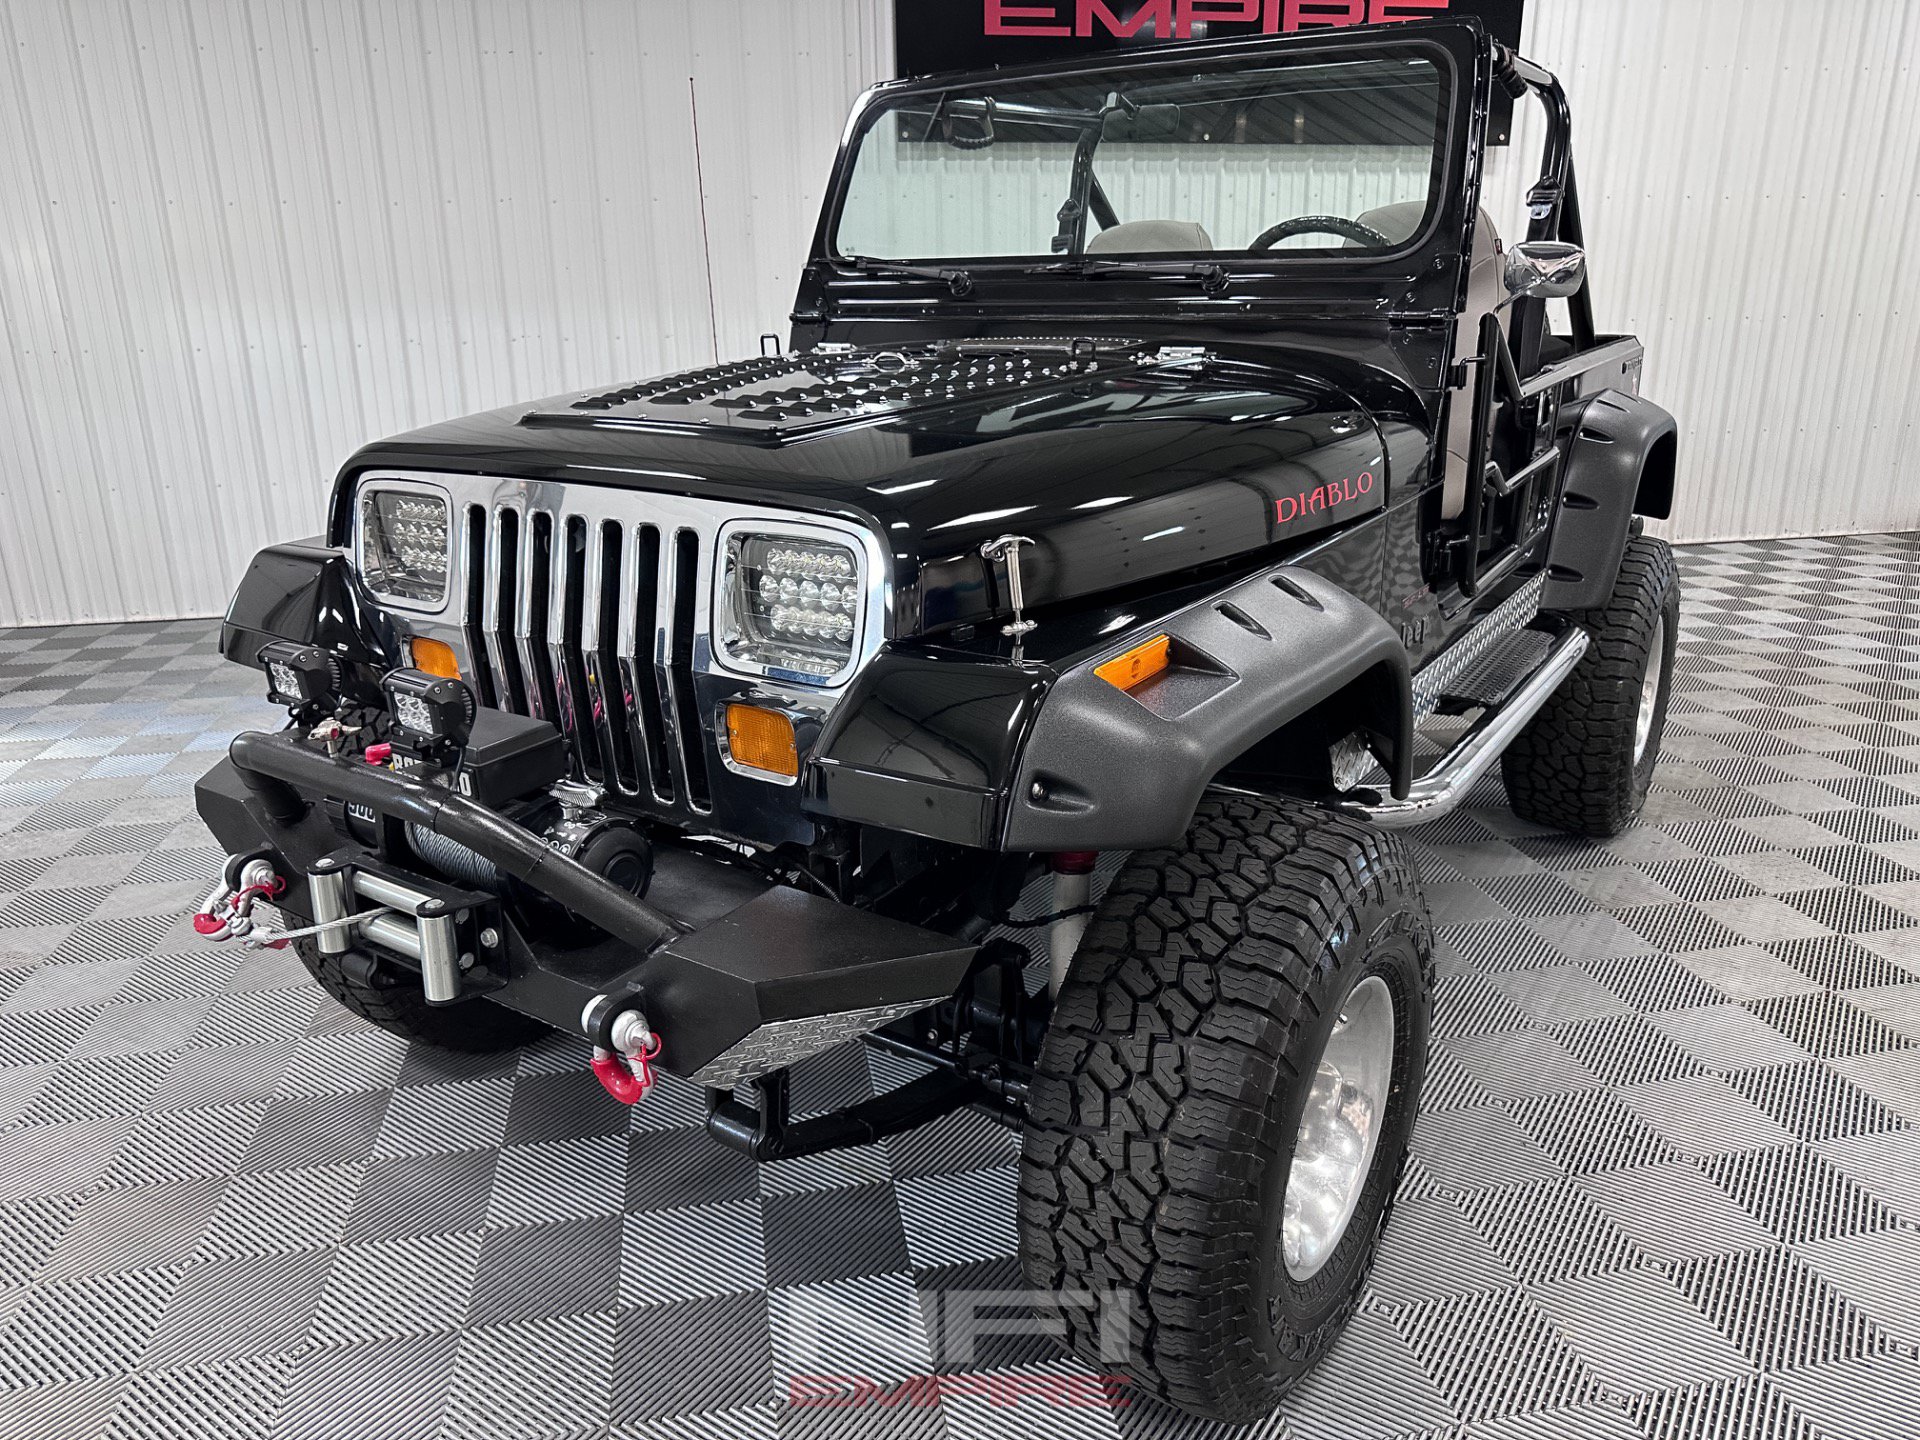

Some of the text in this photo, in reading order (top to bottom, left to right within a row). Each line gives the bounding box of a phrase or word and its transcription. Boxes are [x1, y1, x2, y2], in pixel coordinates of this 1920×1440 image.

[984, 0, 1449, 39] EMPIRE
[1275, 471, 1373, 524] DIABLO
[1401, 613, 1431, 650] Jeep
